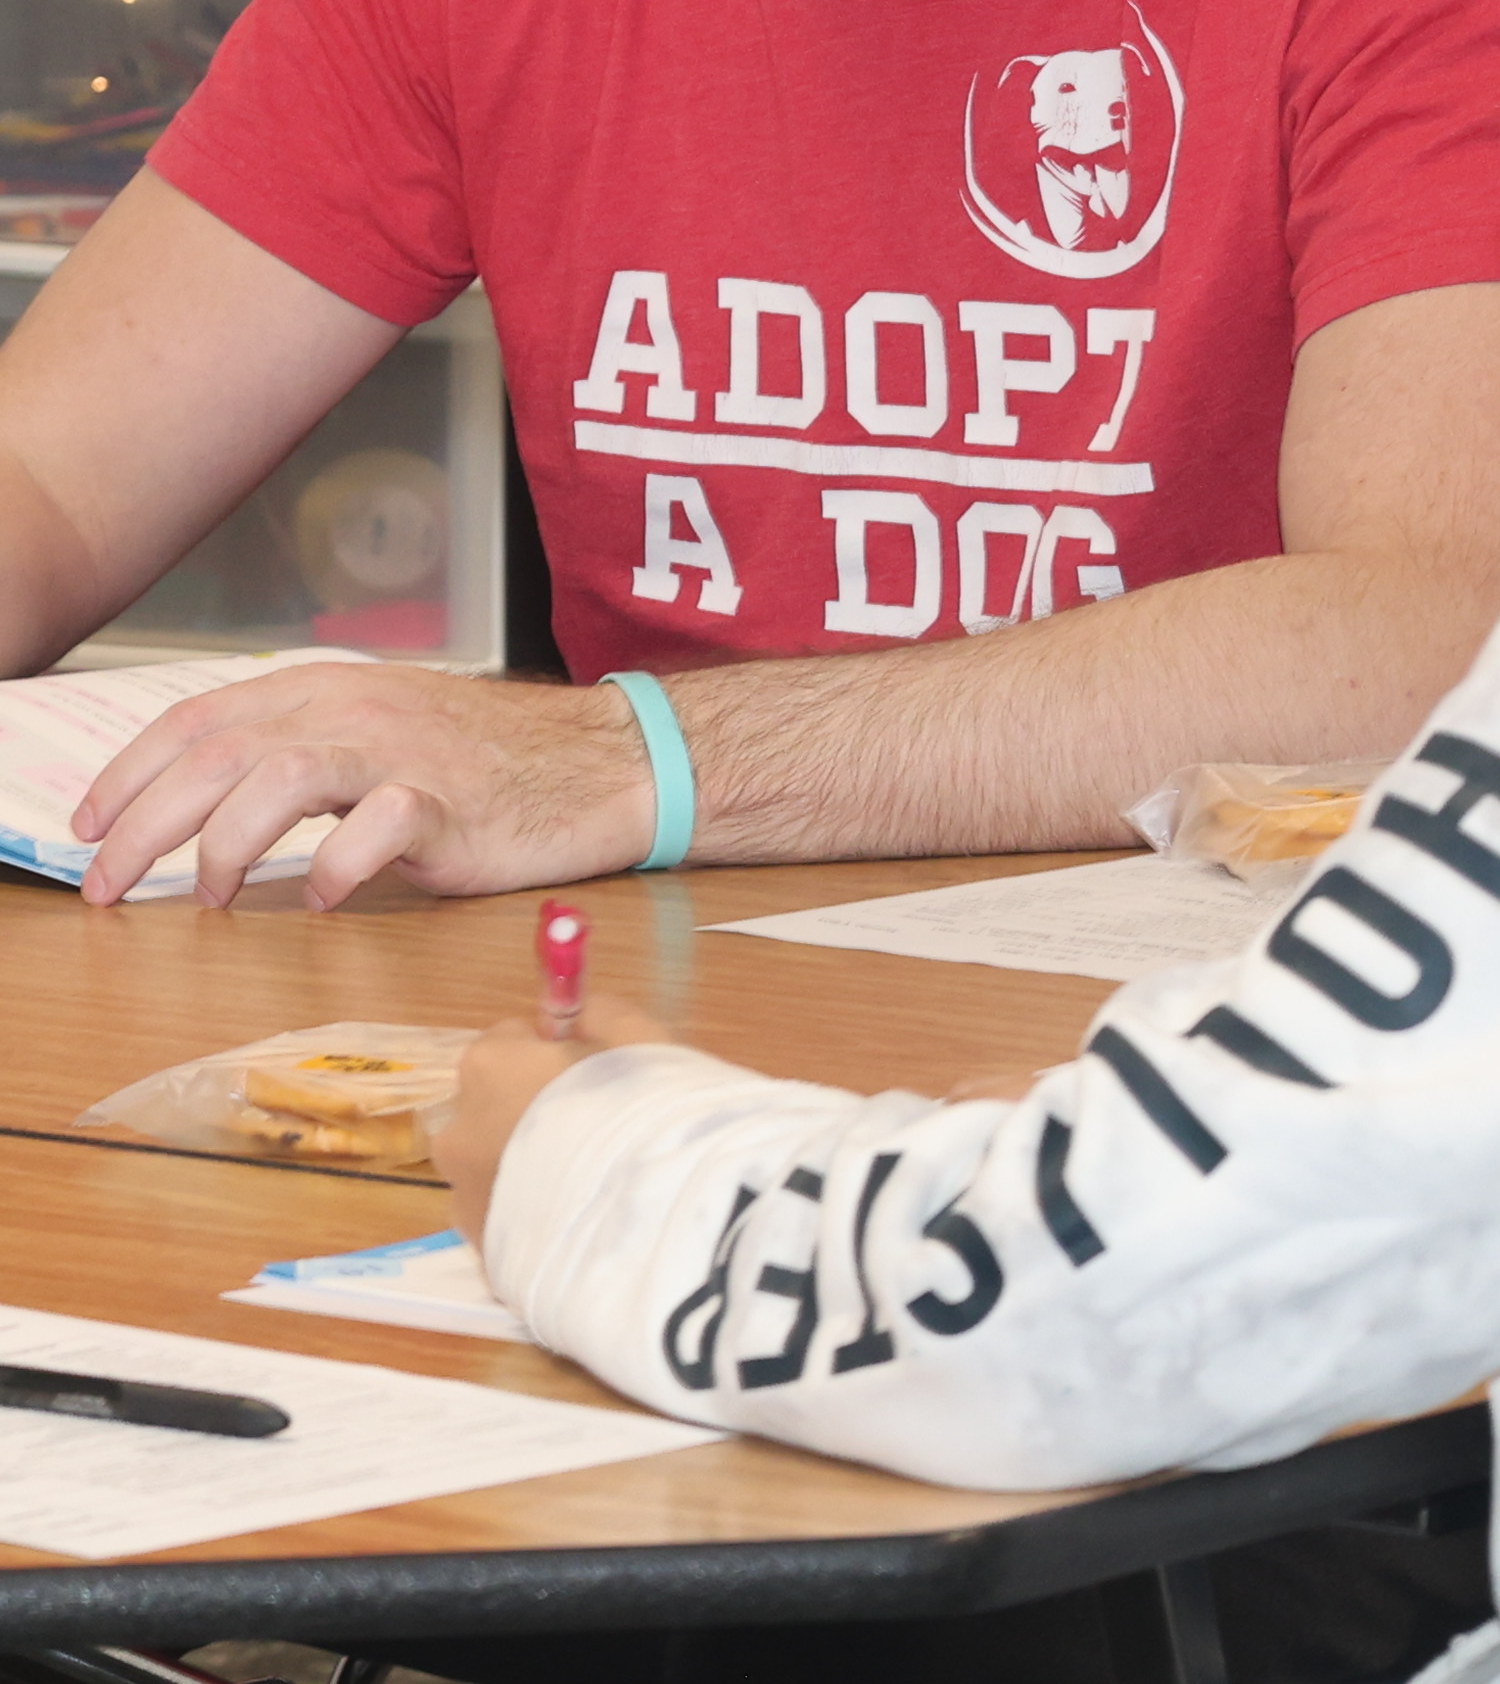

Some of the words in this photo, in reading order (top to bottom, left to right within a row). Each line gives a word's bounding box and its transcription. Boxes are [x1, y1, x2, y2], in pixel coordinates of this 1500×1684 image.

[572, 269, 1157, 452] ADOPT
[631, 472, 744, 616] A
[821, 488, 1126, 640] DOG
